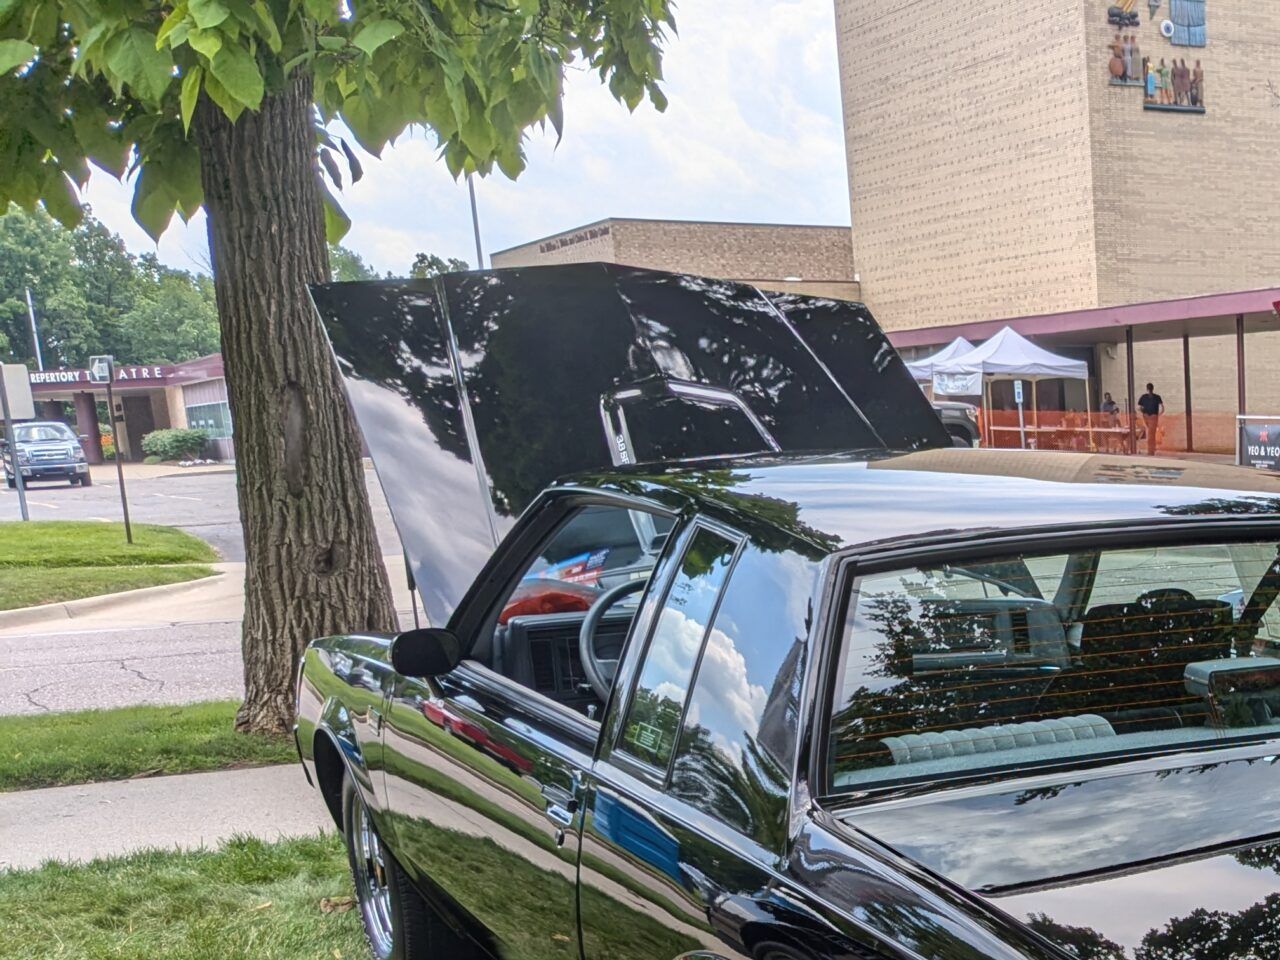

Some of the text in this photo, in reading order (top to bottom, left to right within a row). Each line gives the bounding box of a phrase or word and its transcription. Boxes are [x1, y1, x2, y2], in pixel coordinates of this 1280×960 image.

[30, 367, 162, 384] REPERTORY TATRE
[1248, 445, 1280, 457] YEO & YEO
